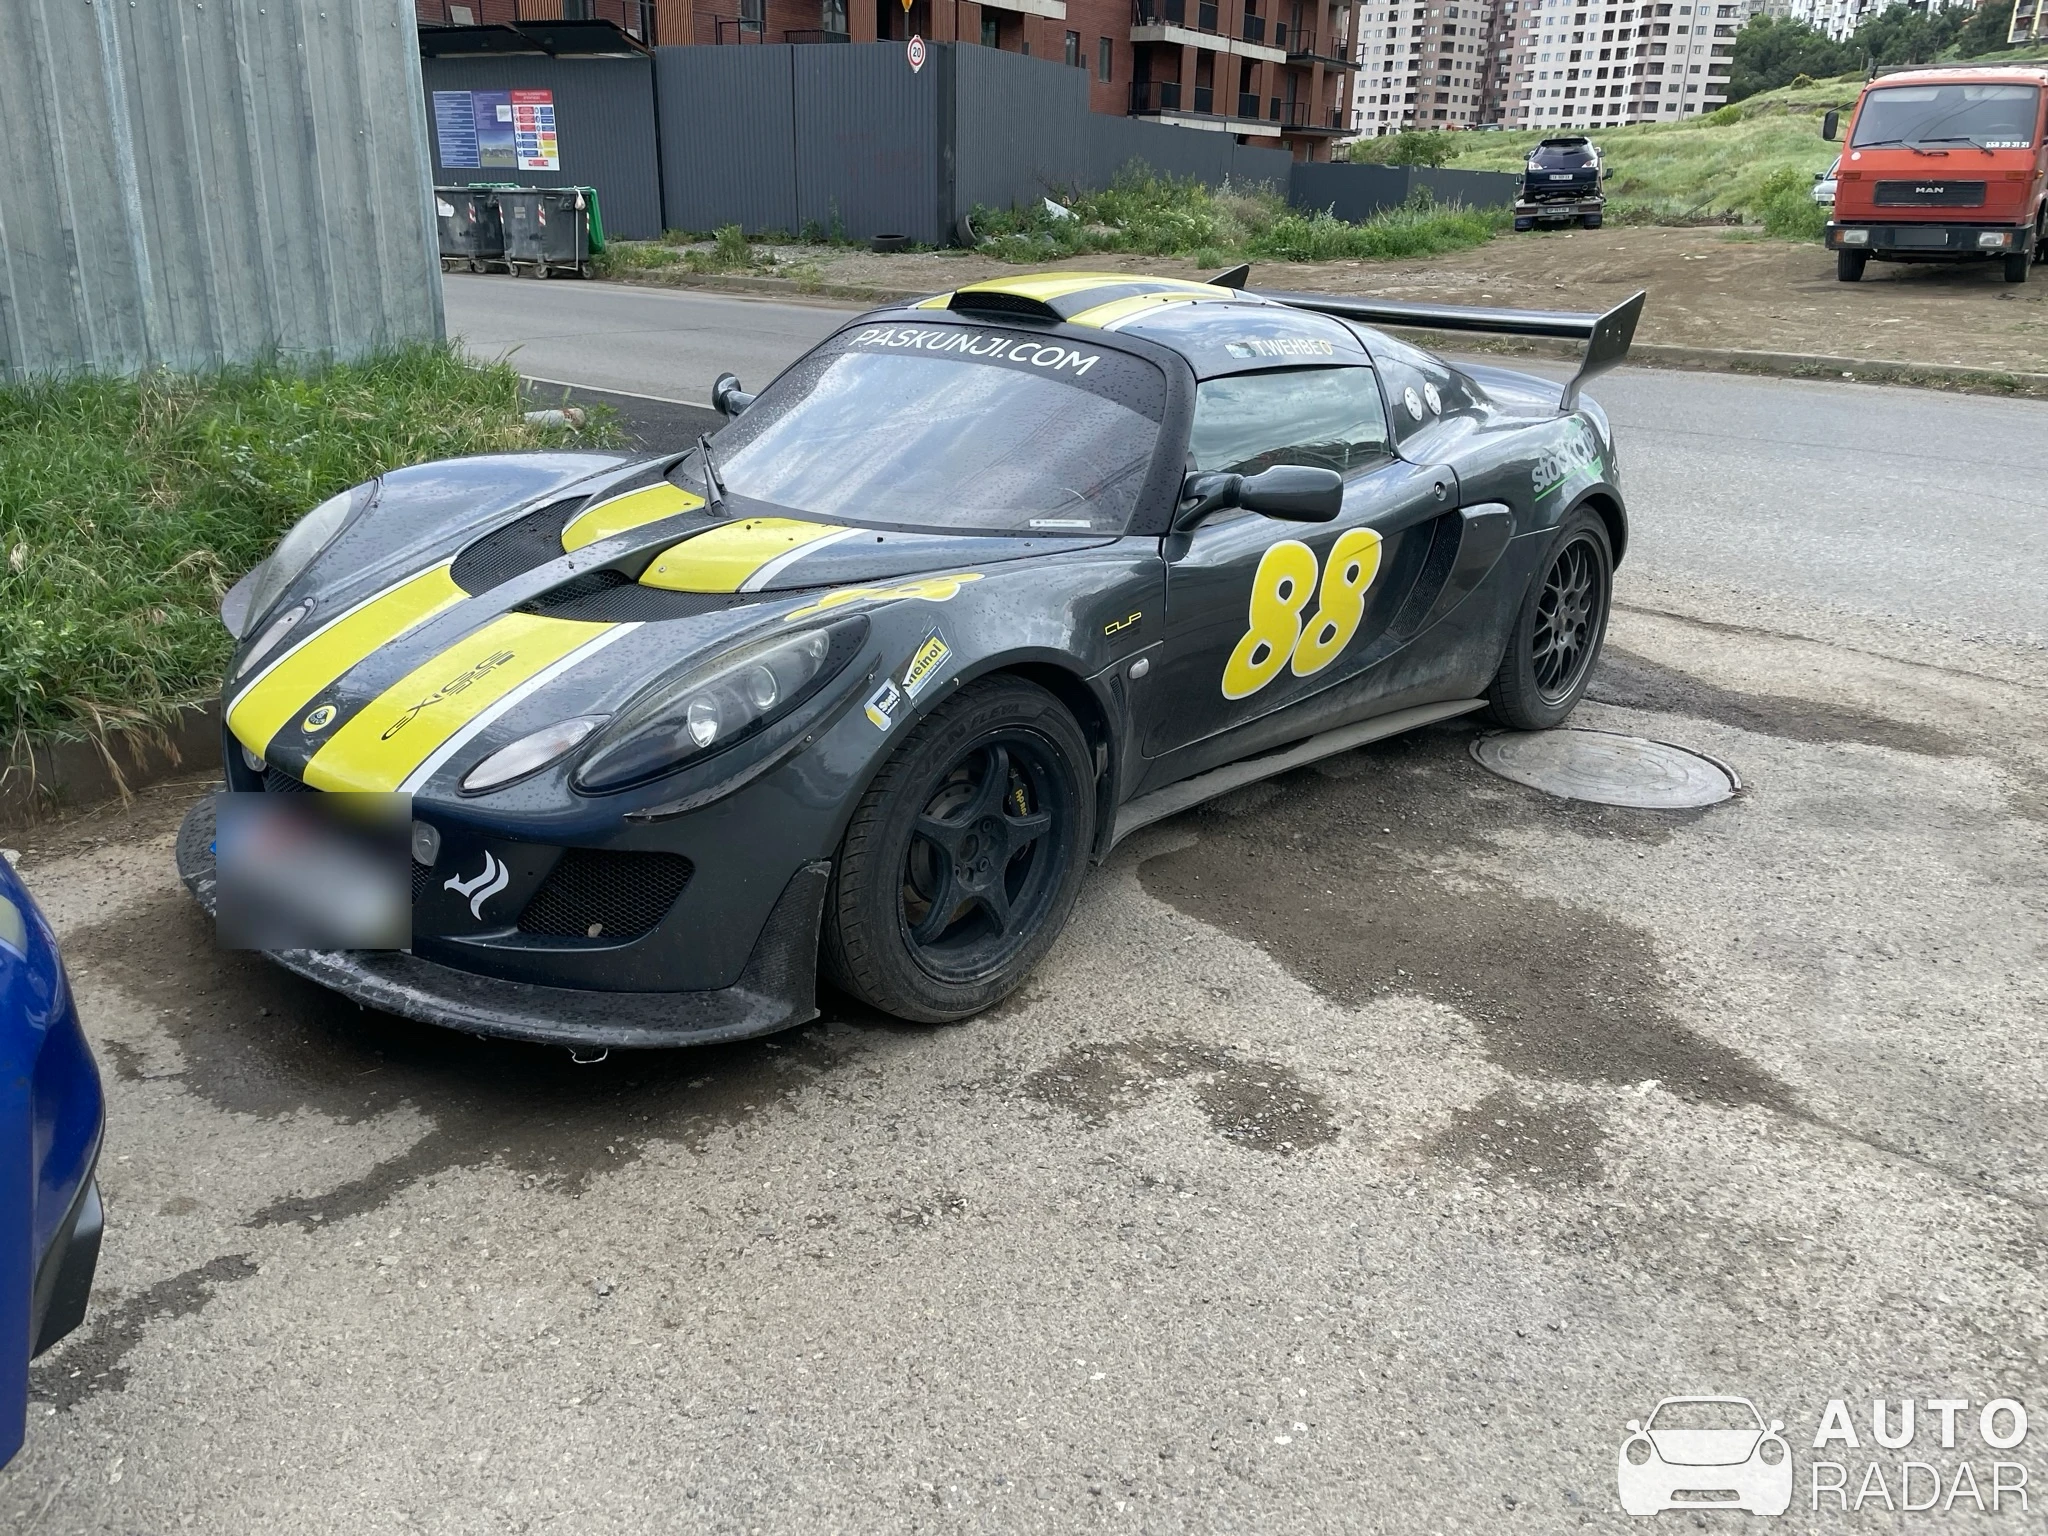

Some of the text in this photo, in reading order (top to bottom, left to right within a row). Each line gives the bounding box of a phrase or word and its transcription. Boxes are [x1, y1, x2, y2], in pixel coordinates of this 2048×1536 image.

[848, 329, 1100, 376] PASKUNJI.COM
[1104, 611, 1142, 636] CUP
[1221, 527, 1384, 700] 88
